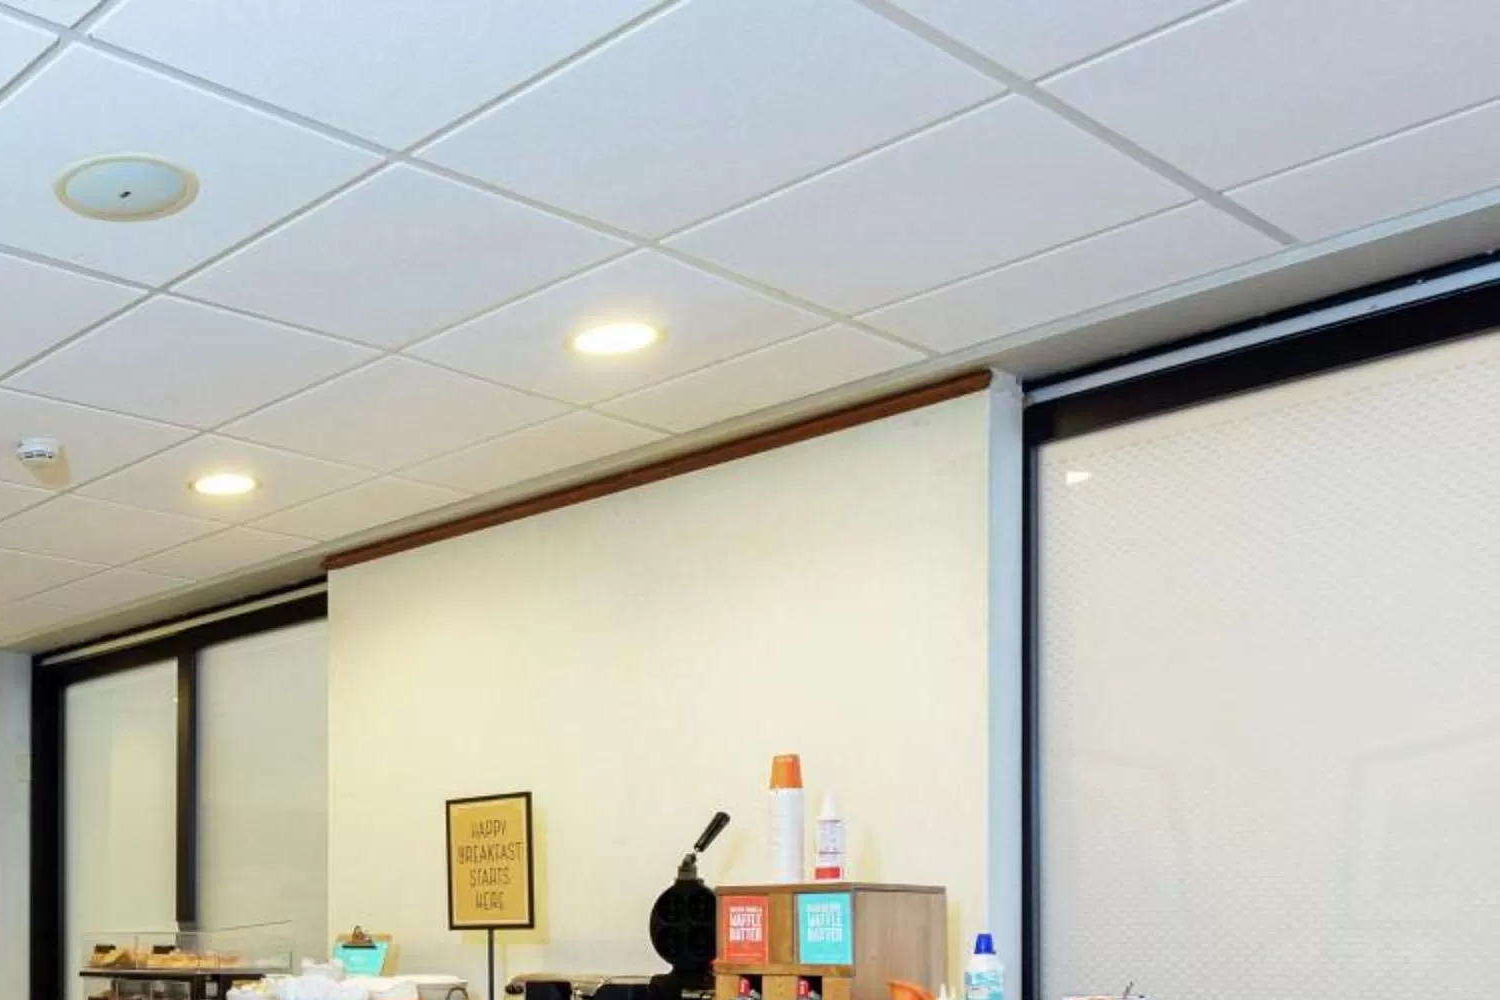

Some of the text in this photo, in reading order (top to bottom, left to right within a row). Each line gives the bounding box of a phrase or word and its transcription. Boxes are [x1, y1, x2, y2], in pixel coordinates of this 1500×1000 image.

[471, 819, 506, 838] HAPPY
[457, 841, 523, 865] BREAKFAST
[469, 867, 511, 888] STARTS
[475, 891, 505, 910] HERE
